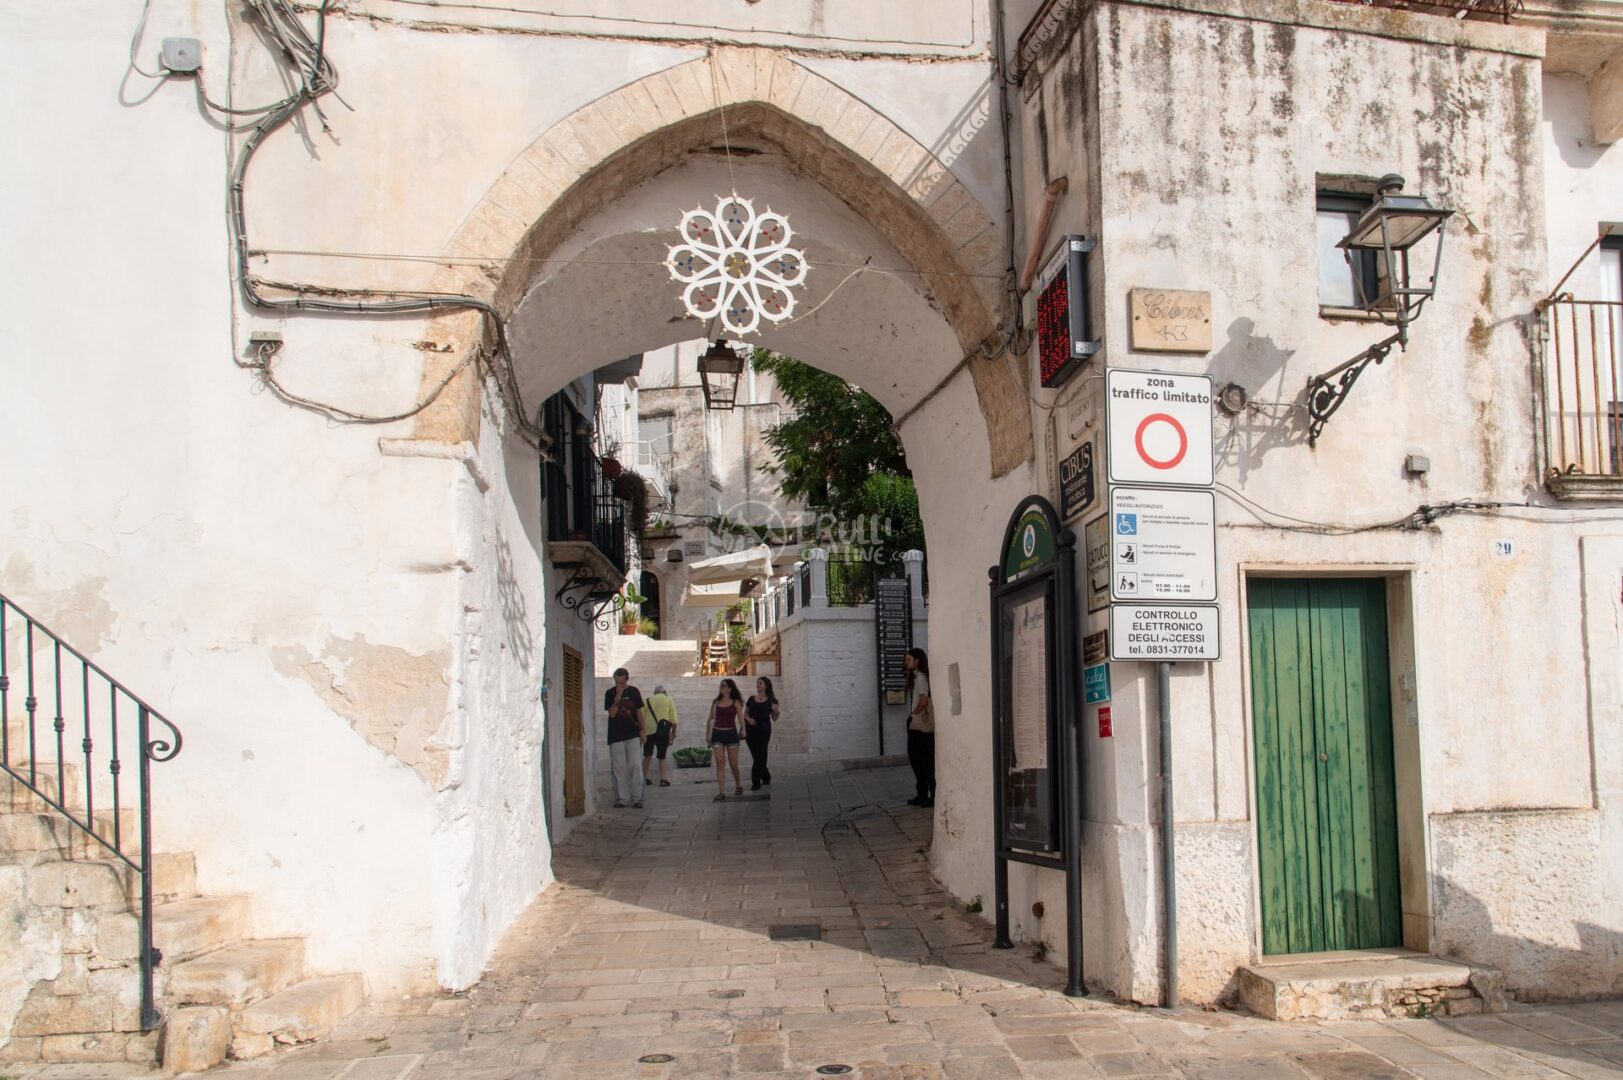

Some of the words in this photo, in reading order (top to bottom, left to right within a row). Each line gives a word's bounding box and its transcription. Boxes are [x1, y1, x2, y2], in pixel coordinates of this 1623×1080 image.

[1143, 293, 1205, 320] Cibus
[1147, 378, 1174, 387] zona
[1112, 387, 1158, 400] traffico
[1163, 390, 1209, 403] limitato
[1061, 445, 1090, 484] CIBUS
[1495, 542, 1511, 556] 29
[1135, 611, 1197, 620] CONTROLLO
[1132, 622, 1203, 631] ELETTRONICO
[1128, 634, 1159, 642] DEGLI
[1161, 634, 1205, 643] ACCESSI
[1129, 645, 1143, 654] tel.
[1146, 645, 1204, 654] 0831-377014
